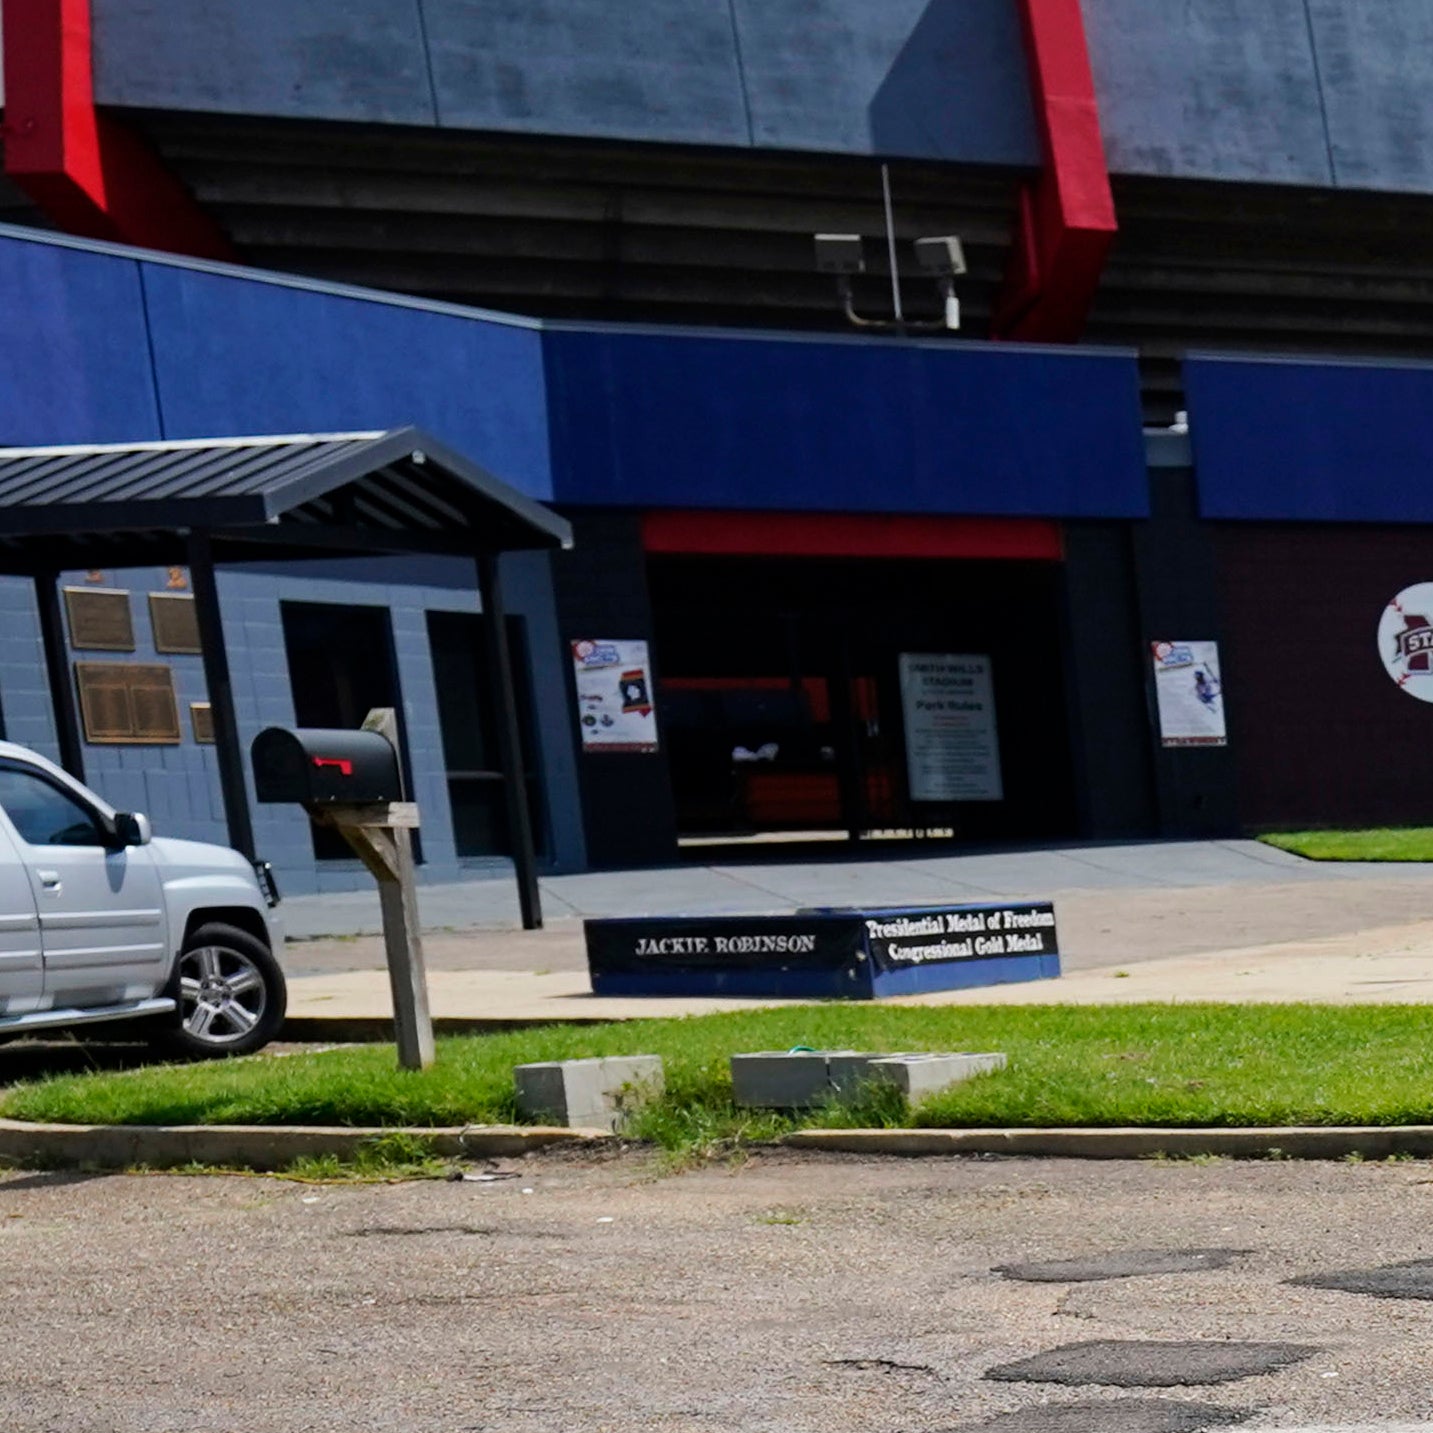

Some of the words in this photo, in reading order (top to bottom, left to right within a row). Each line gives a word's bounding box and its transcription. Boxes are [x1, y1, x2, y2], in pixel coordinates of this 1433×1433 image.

[865, 916, 945, 939] Presidential
[946, 913, 986, 933] Medal
[987, 911, 1001, 930] of
[1002, 909, 1055, 929] Freedom
[635, 938, 710, 955] JACKIE
[714, 935, 817, 953] ROBINSON
[888, 938, 973, 963] Congressional
[974, 936, 1005, 955] Gold
[1006, 933, 1044, 952] Medal
